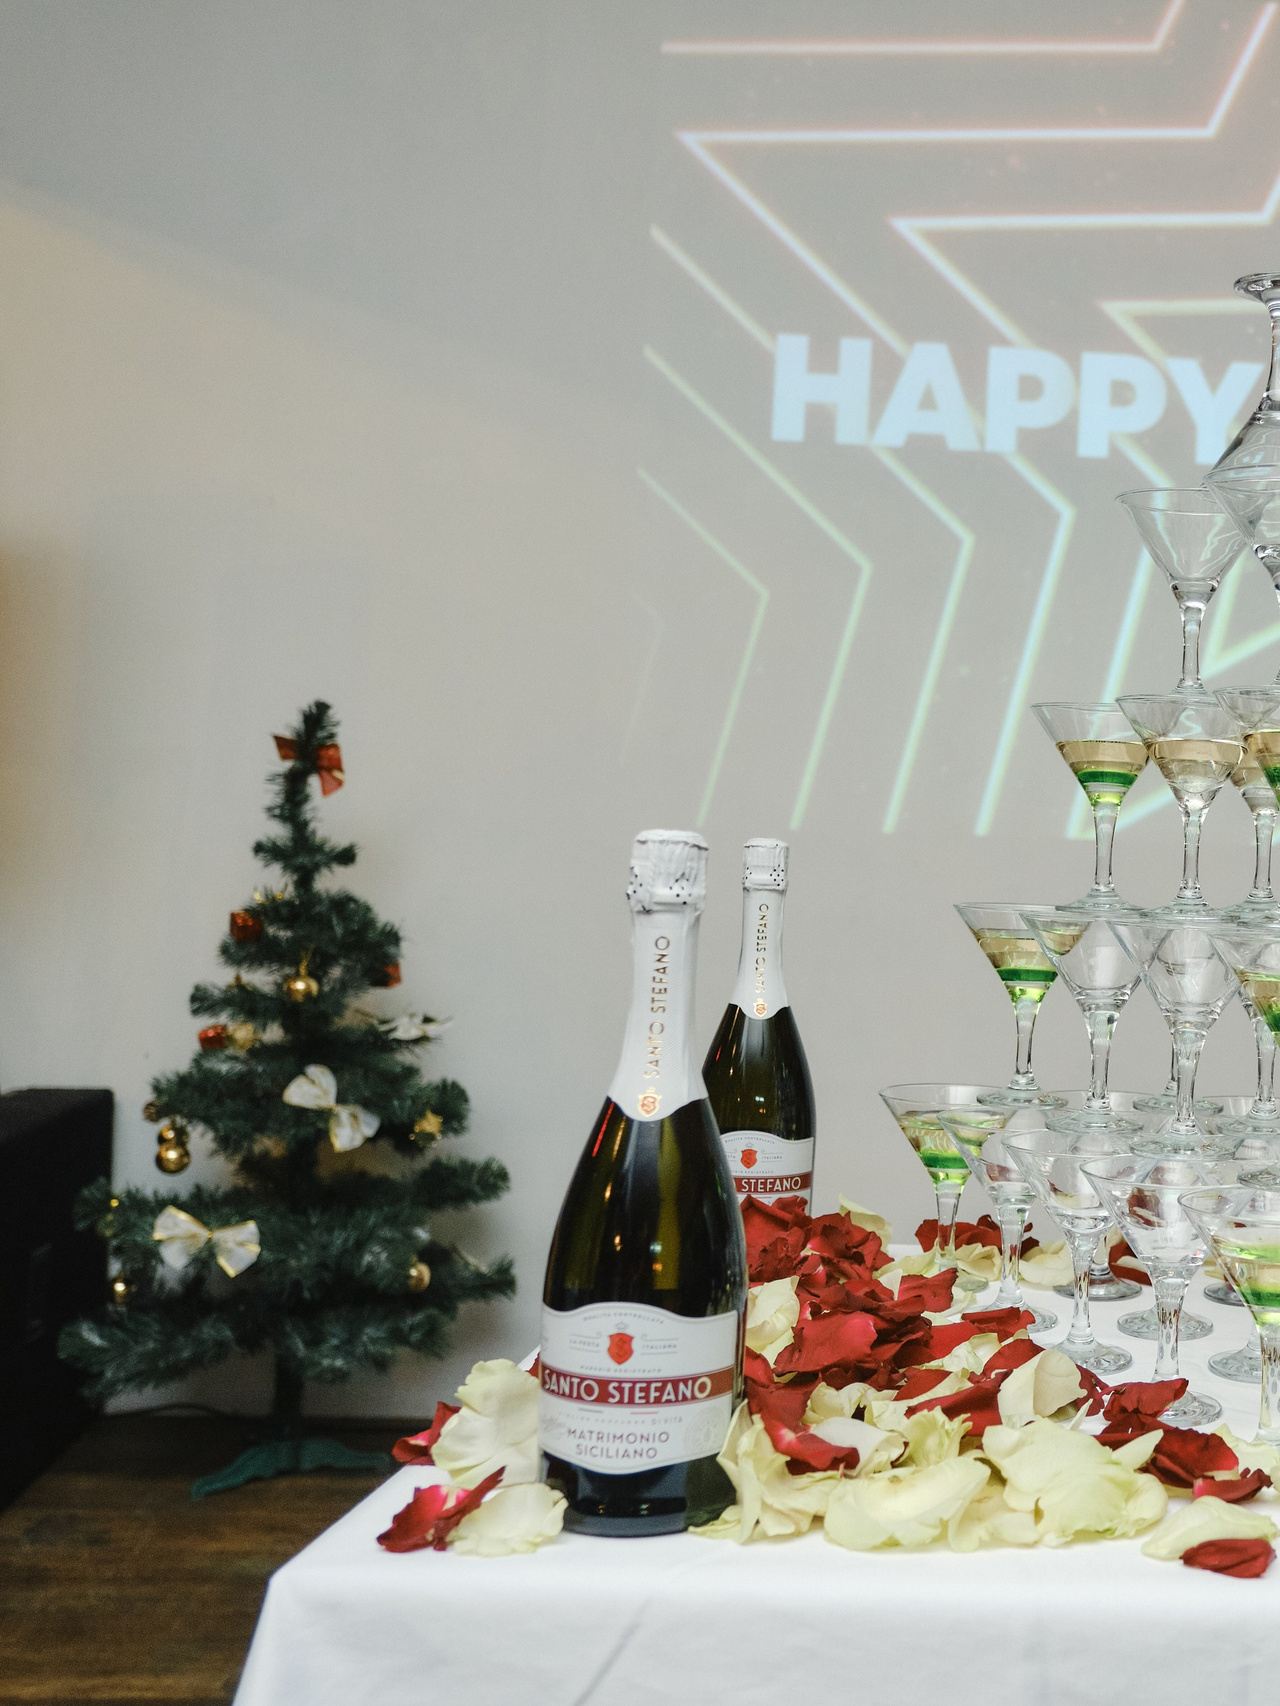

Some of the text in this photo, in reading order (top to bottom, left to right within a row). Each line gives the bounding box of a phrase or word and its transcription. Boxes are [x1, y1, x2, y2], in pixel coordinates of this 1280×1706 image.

[770, 333, 1264, 465] HAPPY
[755, 904, 769, 993] SANTO STEFANO
[643, 936, 670, 1078] SANTO STEFANO
[741, 1177, 802, 1192] STEFANO
[544, 1369, 712, 1404] SANTO STEFANO
[566, 1428, 670, 1444] MATRIMONIO
[576, 1444, 658, 1460] SICILIANO
